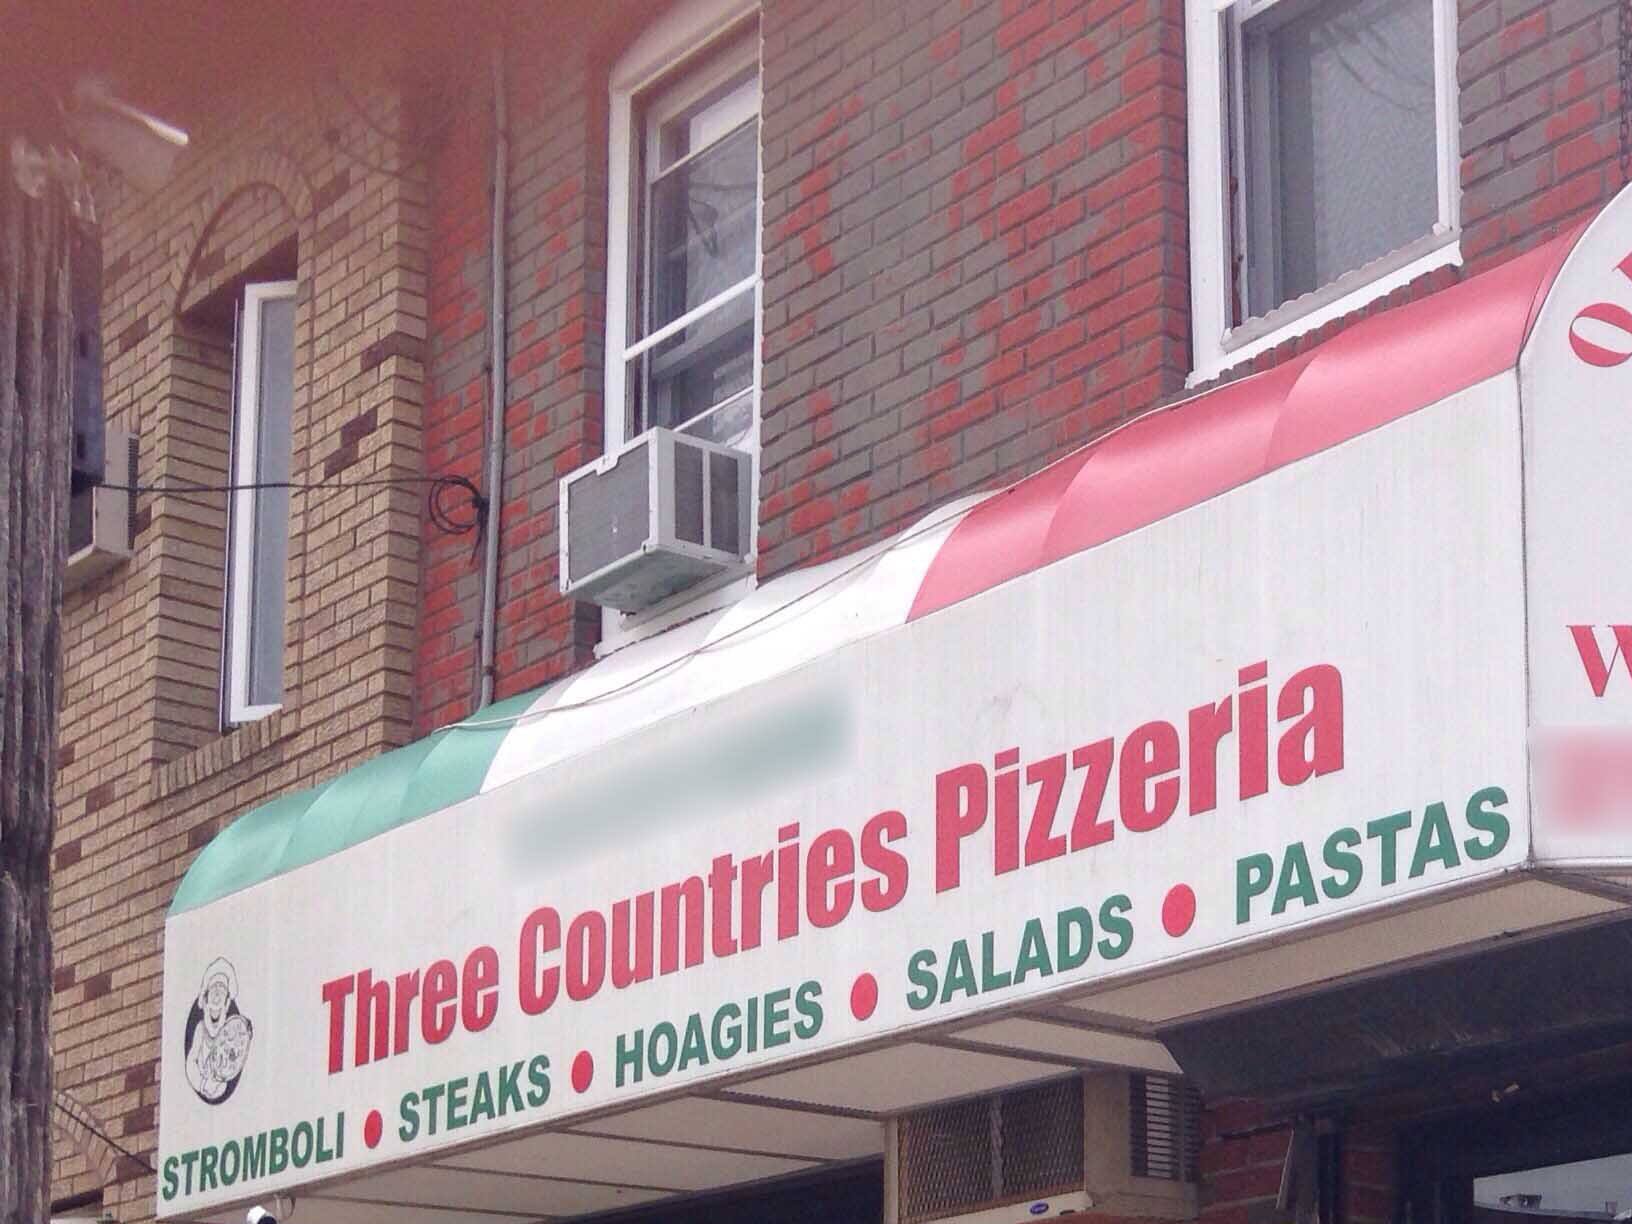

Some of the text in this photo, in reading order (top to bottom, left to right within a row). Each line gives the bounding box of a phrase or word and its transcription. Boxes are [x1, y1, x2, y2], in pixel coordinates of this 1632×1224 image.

[162, 787, 1511, 1201] STROMBOLI STEAKS HOAGIES SALADS PASTAS
[322, 945, 500, 1075] Three
[518, 809, 909, 1017] Countries
[935, 660, 1345, 894] Pizzeria
